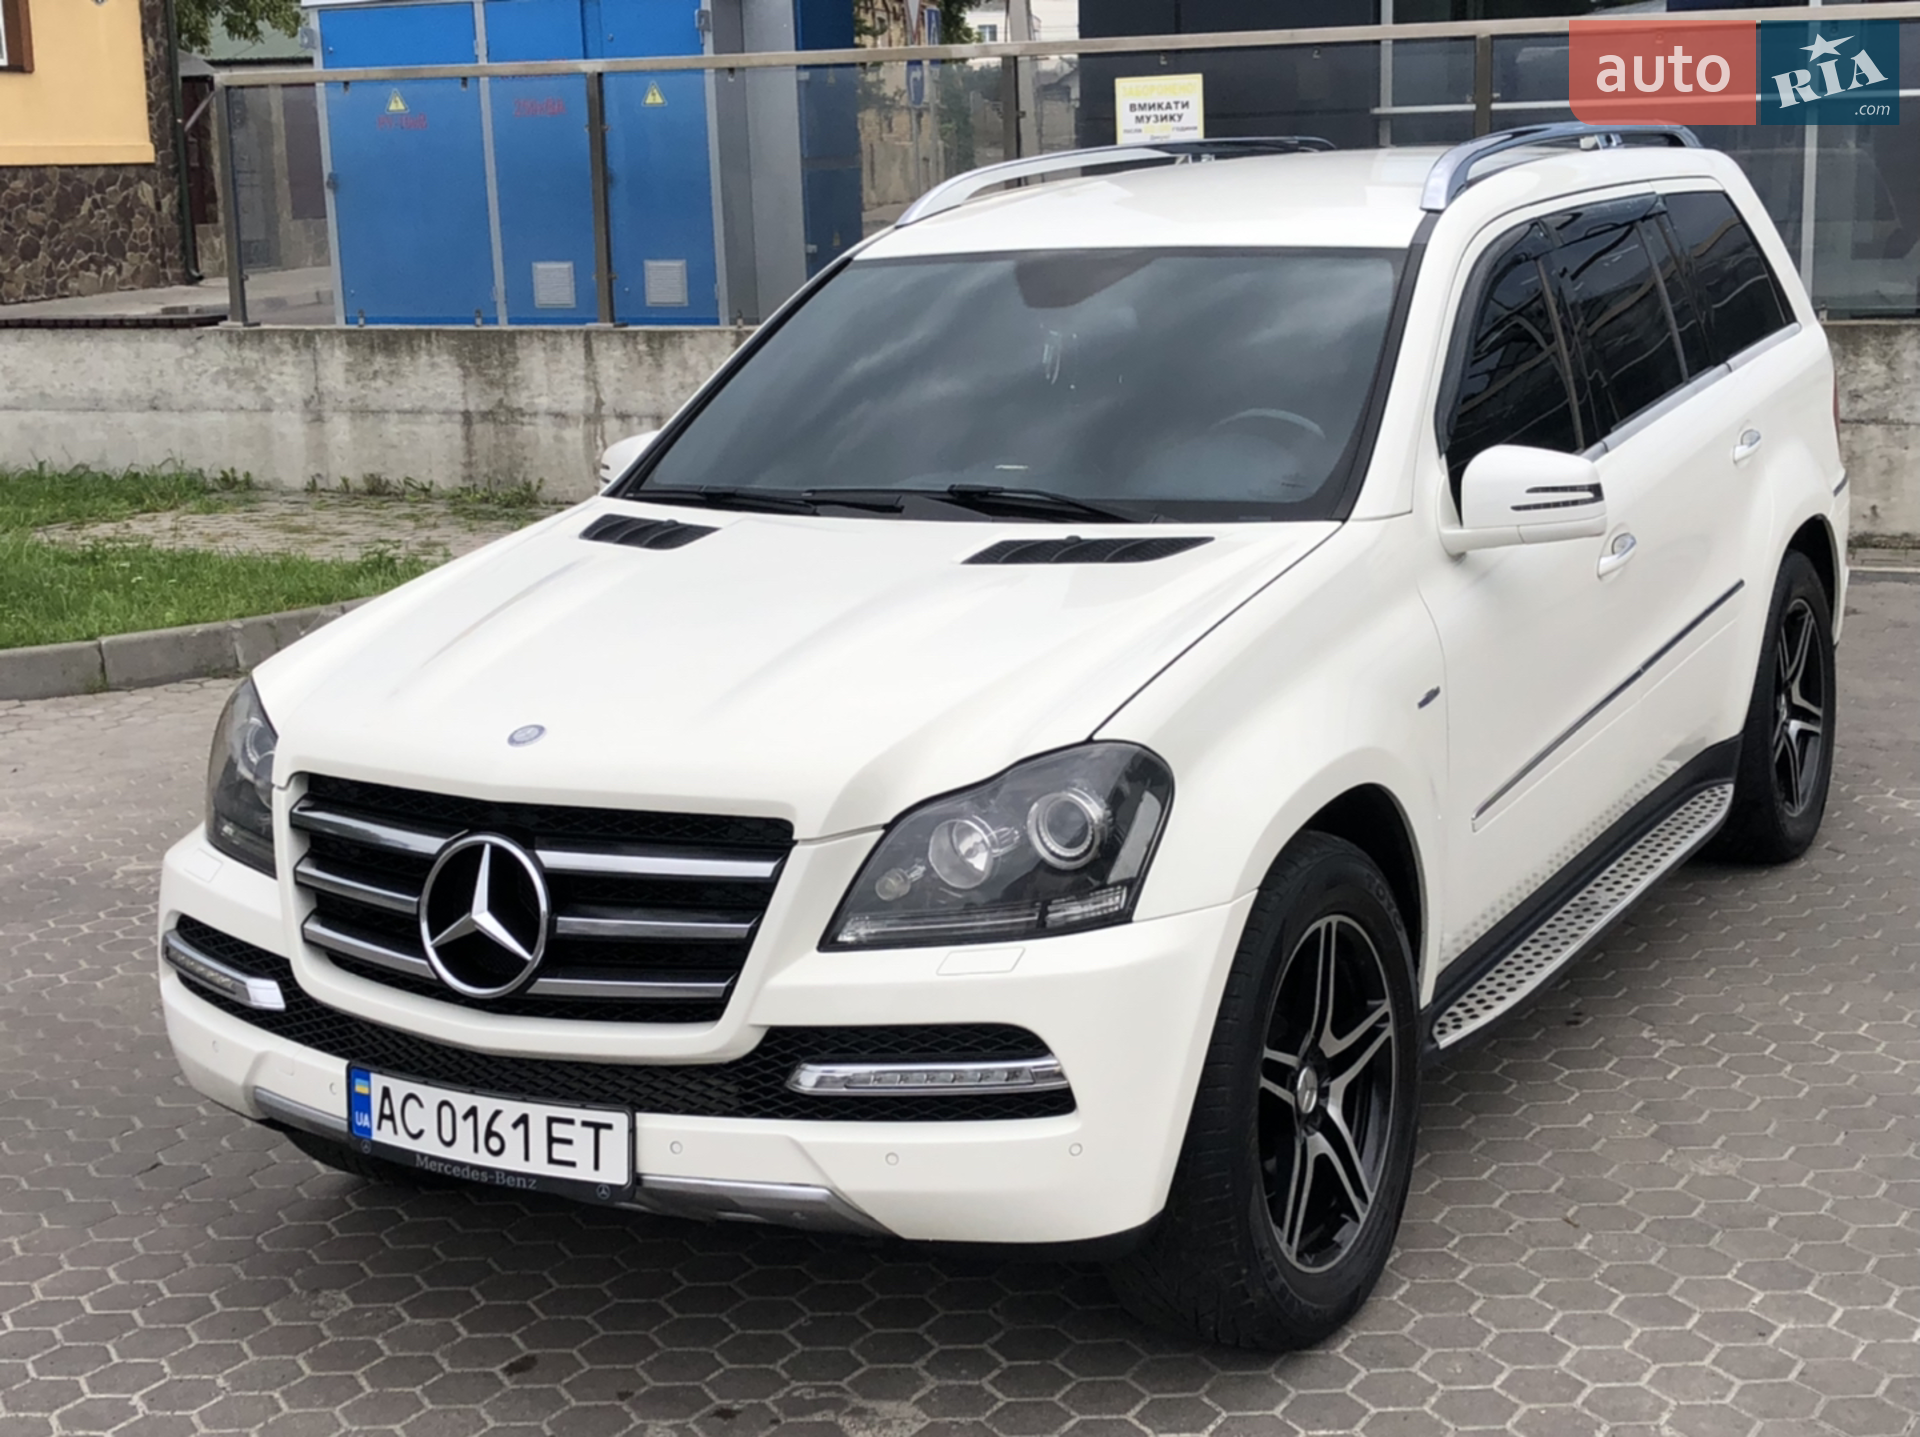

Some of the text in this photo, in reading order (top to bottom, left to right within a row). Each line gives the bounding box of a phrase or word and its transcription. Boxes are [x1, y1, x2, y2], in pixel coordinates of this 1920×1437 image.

[1129, 100, 1190, 112] ВМИКАТИ
[1135, 113, 1184, 124] МУЗИКУ
[355, 1111, 371, 1129] UA
[376, 1085, 614, 1172] AC 0161 ET
[415, 1154, 538, 1191] Mercedes-Benz
